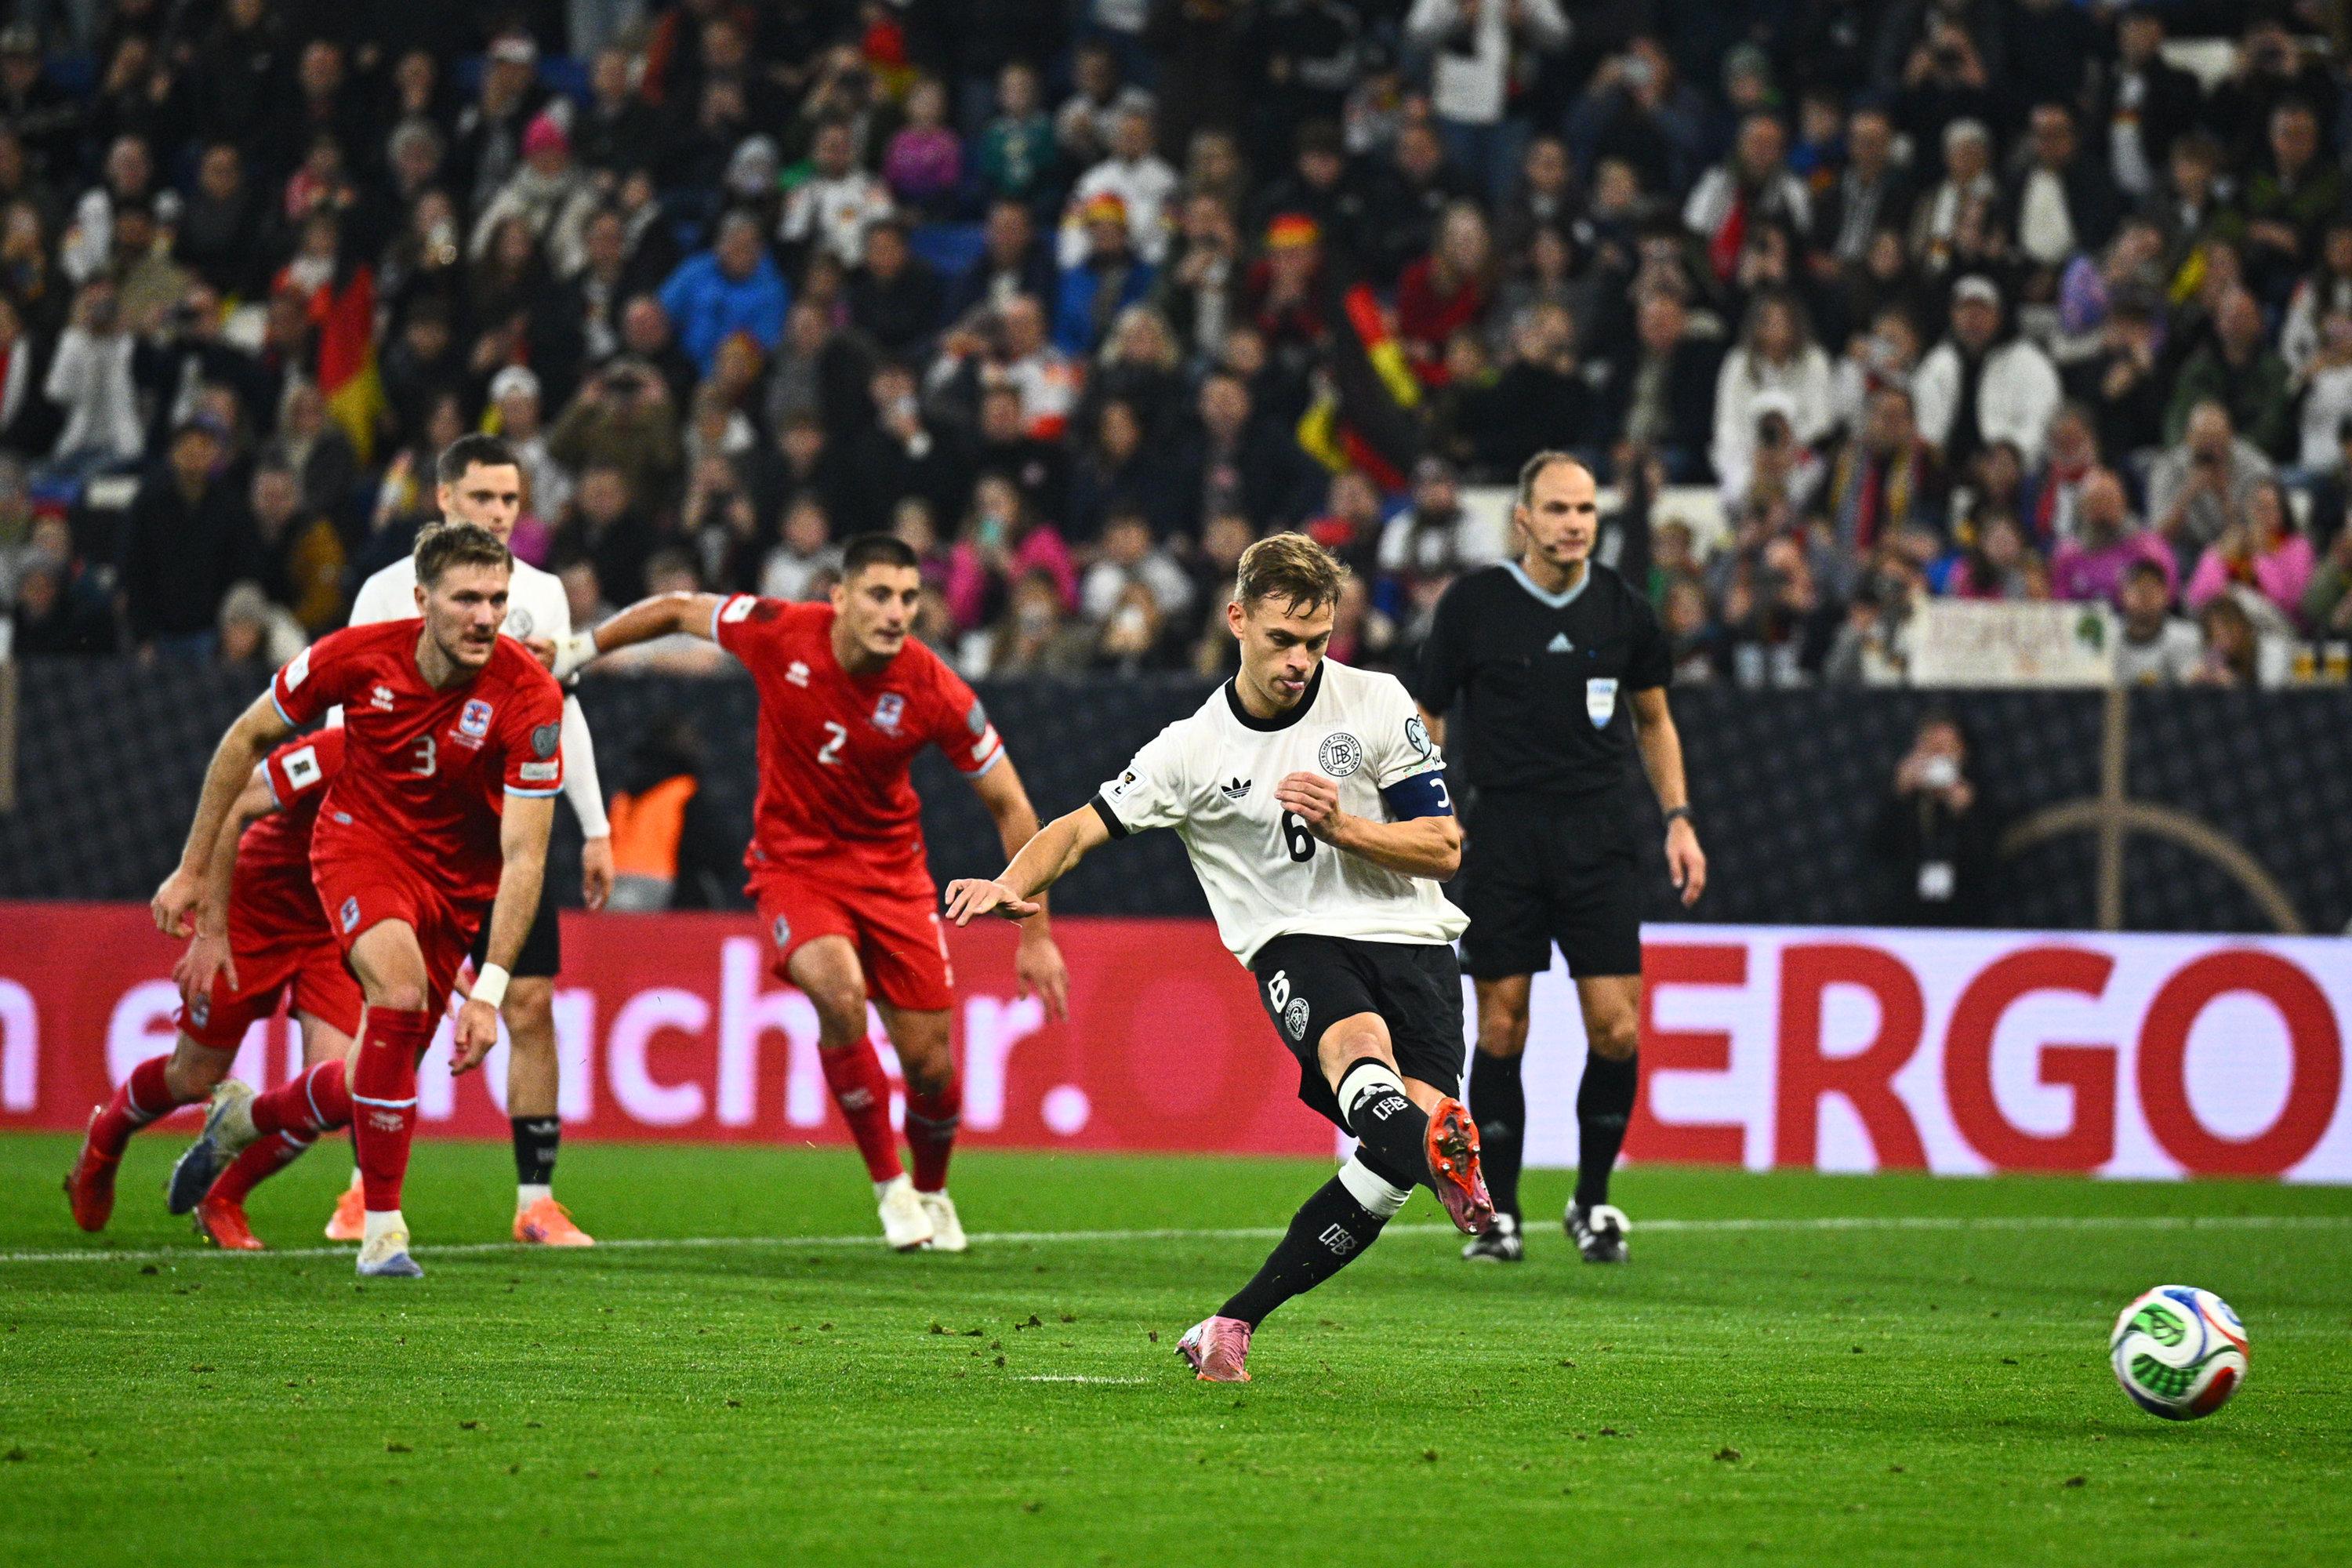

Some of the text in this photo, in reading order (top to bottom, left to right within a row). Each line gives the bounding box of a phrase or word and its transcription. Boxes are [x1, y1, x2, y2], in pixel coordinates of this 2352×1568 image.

[412, 734, 436, 776] 3
[818, 720, 847, 764] 2
[1282, 808, 1316, 862] 6
[1268, 969, 1290, 1014] 6
[1621, 942, 2344, 1180] ERGO
